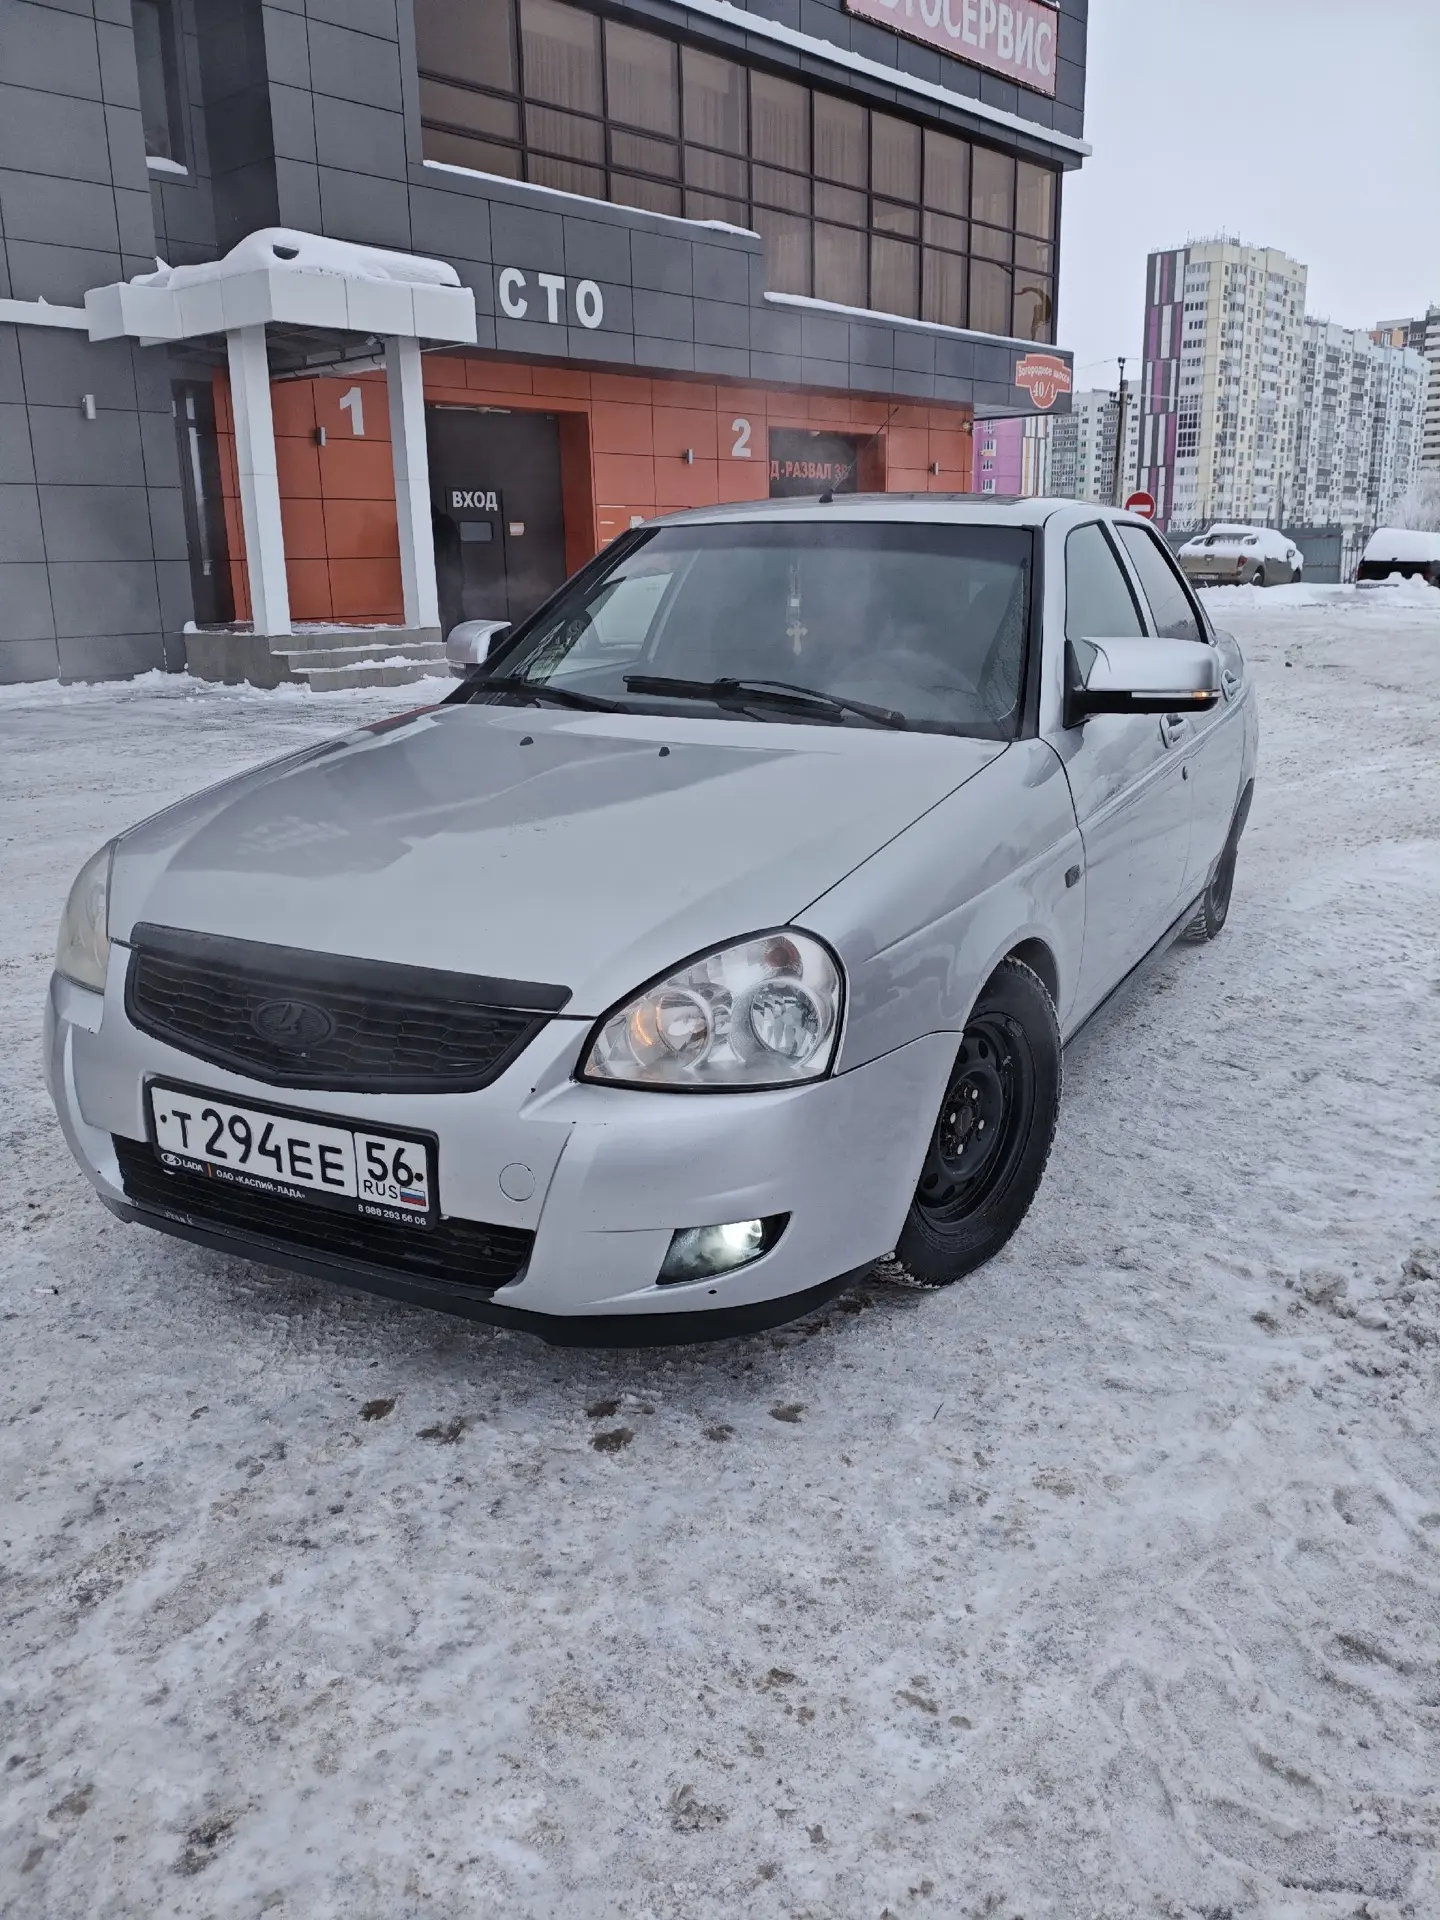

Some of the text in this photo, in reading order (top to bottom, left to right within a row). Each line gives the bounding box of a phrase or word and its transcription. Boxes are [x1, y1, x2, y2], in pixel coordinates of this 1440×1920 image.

[877, 0, 1053, 77] ОСЕРВИС
[499, 267, 603, 328] СТО
[1033, 381, 1055, 398] 40/1
[339, 386, 365, 436] 1
[731, 418, 752, 458] 2
[452, 490, 498, 512] ВХОД
[181, 1159, 204, 1173] LADA
[216, 1169, 234, 1181] ОАО
[366, 1141, 413, 1187] 56
[363, 1181, 399, 1200] RUS
[357, 1203, 364, 1212] 8
[365, 1205, 382, 1217] 988
[383, 1209, 401, 1220] 293
